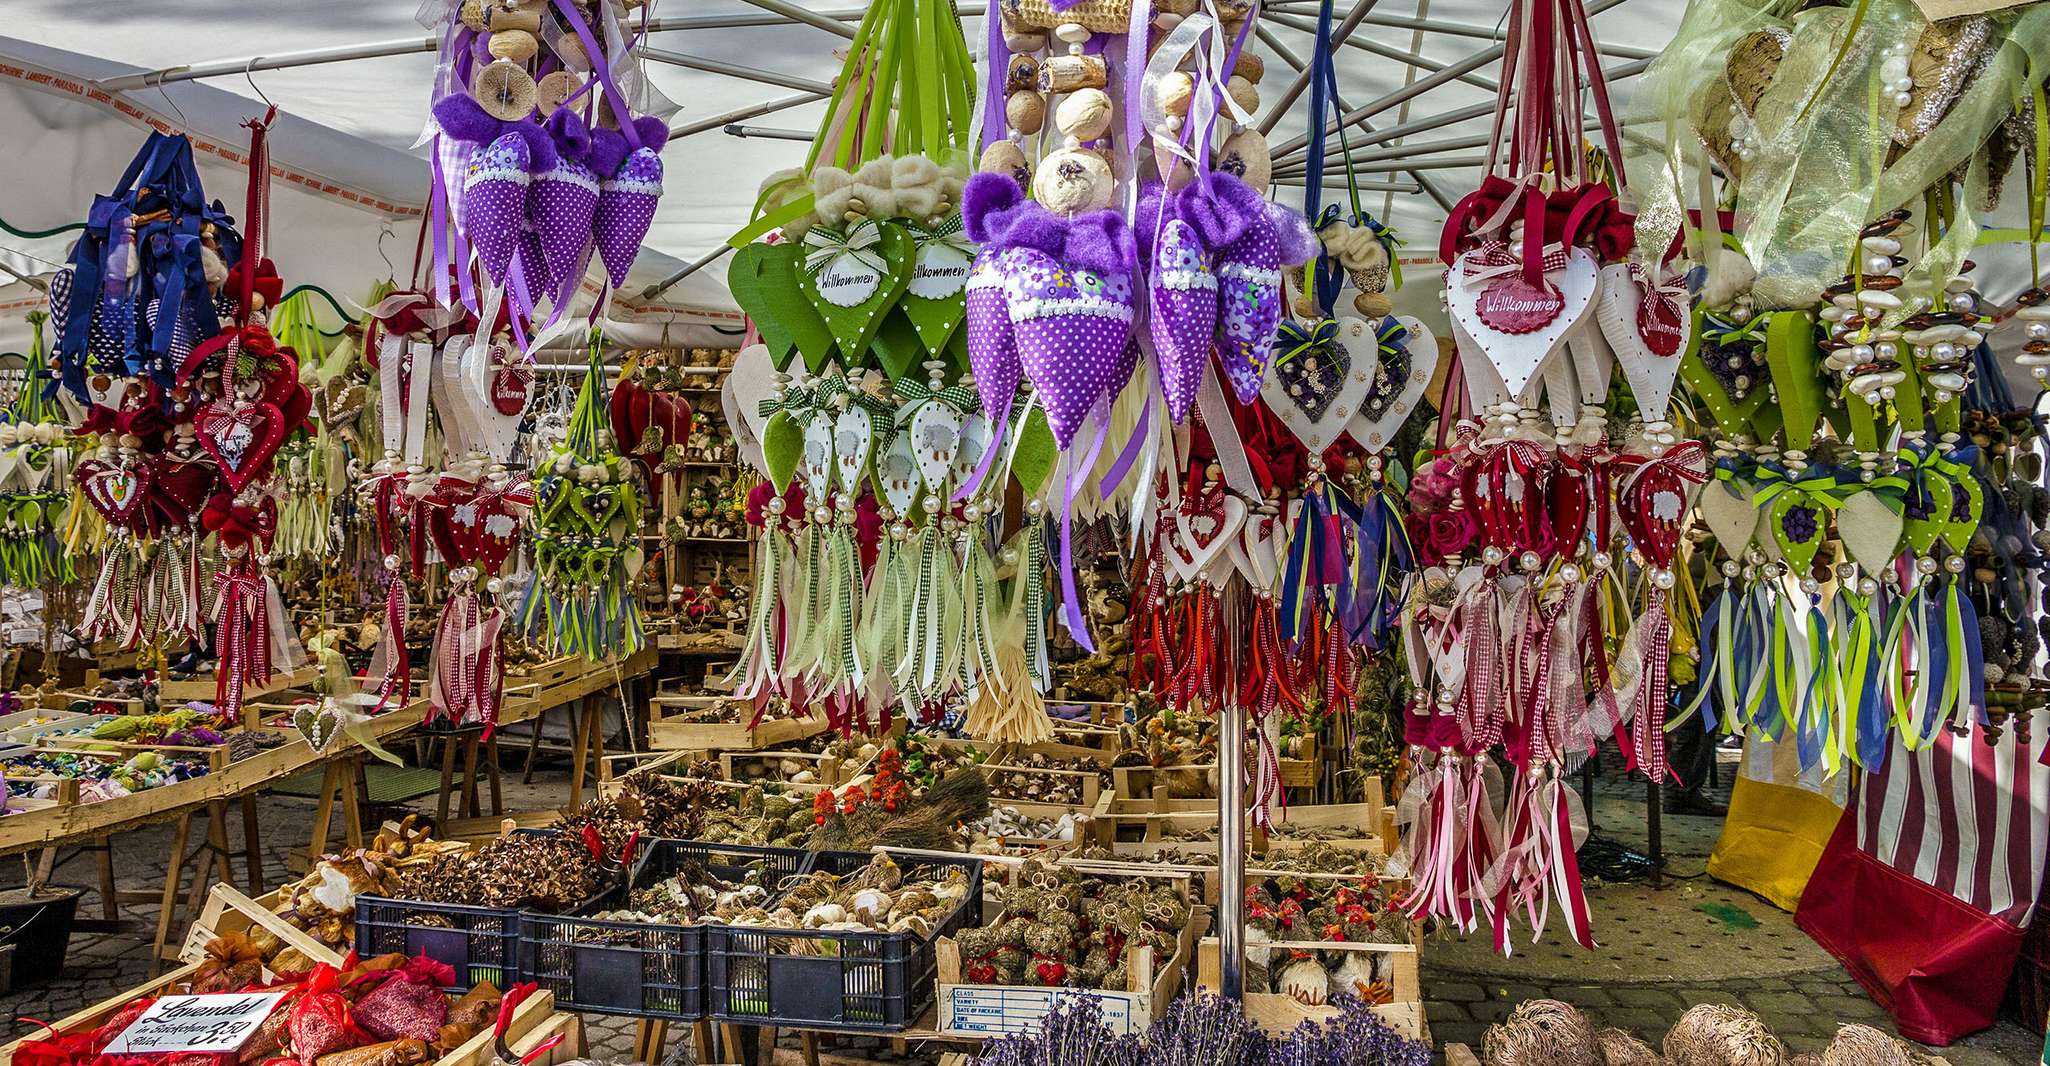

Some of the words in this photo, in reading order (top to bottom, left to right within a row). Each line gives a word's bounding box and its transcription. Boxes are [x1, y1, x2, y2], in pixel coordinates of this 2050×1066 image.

[822, 265, 873, 288] Willkommen
[913, 264, 965, 279] illkommen
[1486, 289, 1560, 313] Willkommen
[142, 997, 268, 1024] Lavendel
[135, 1026, 150, 1034] in
